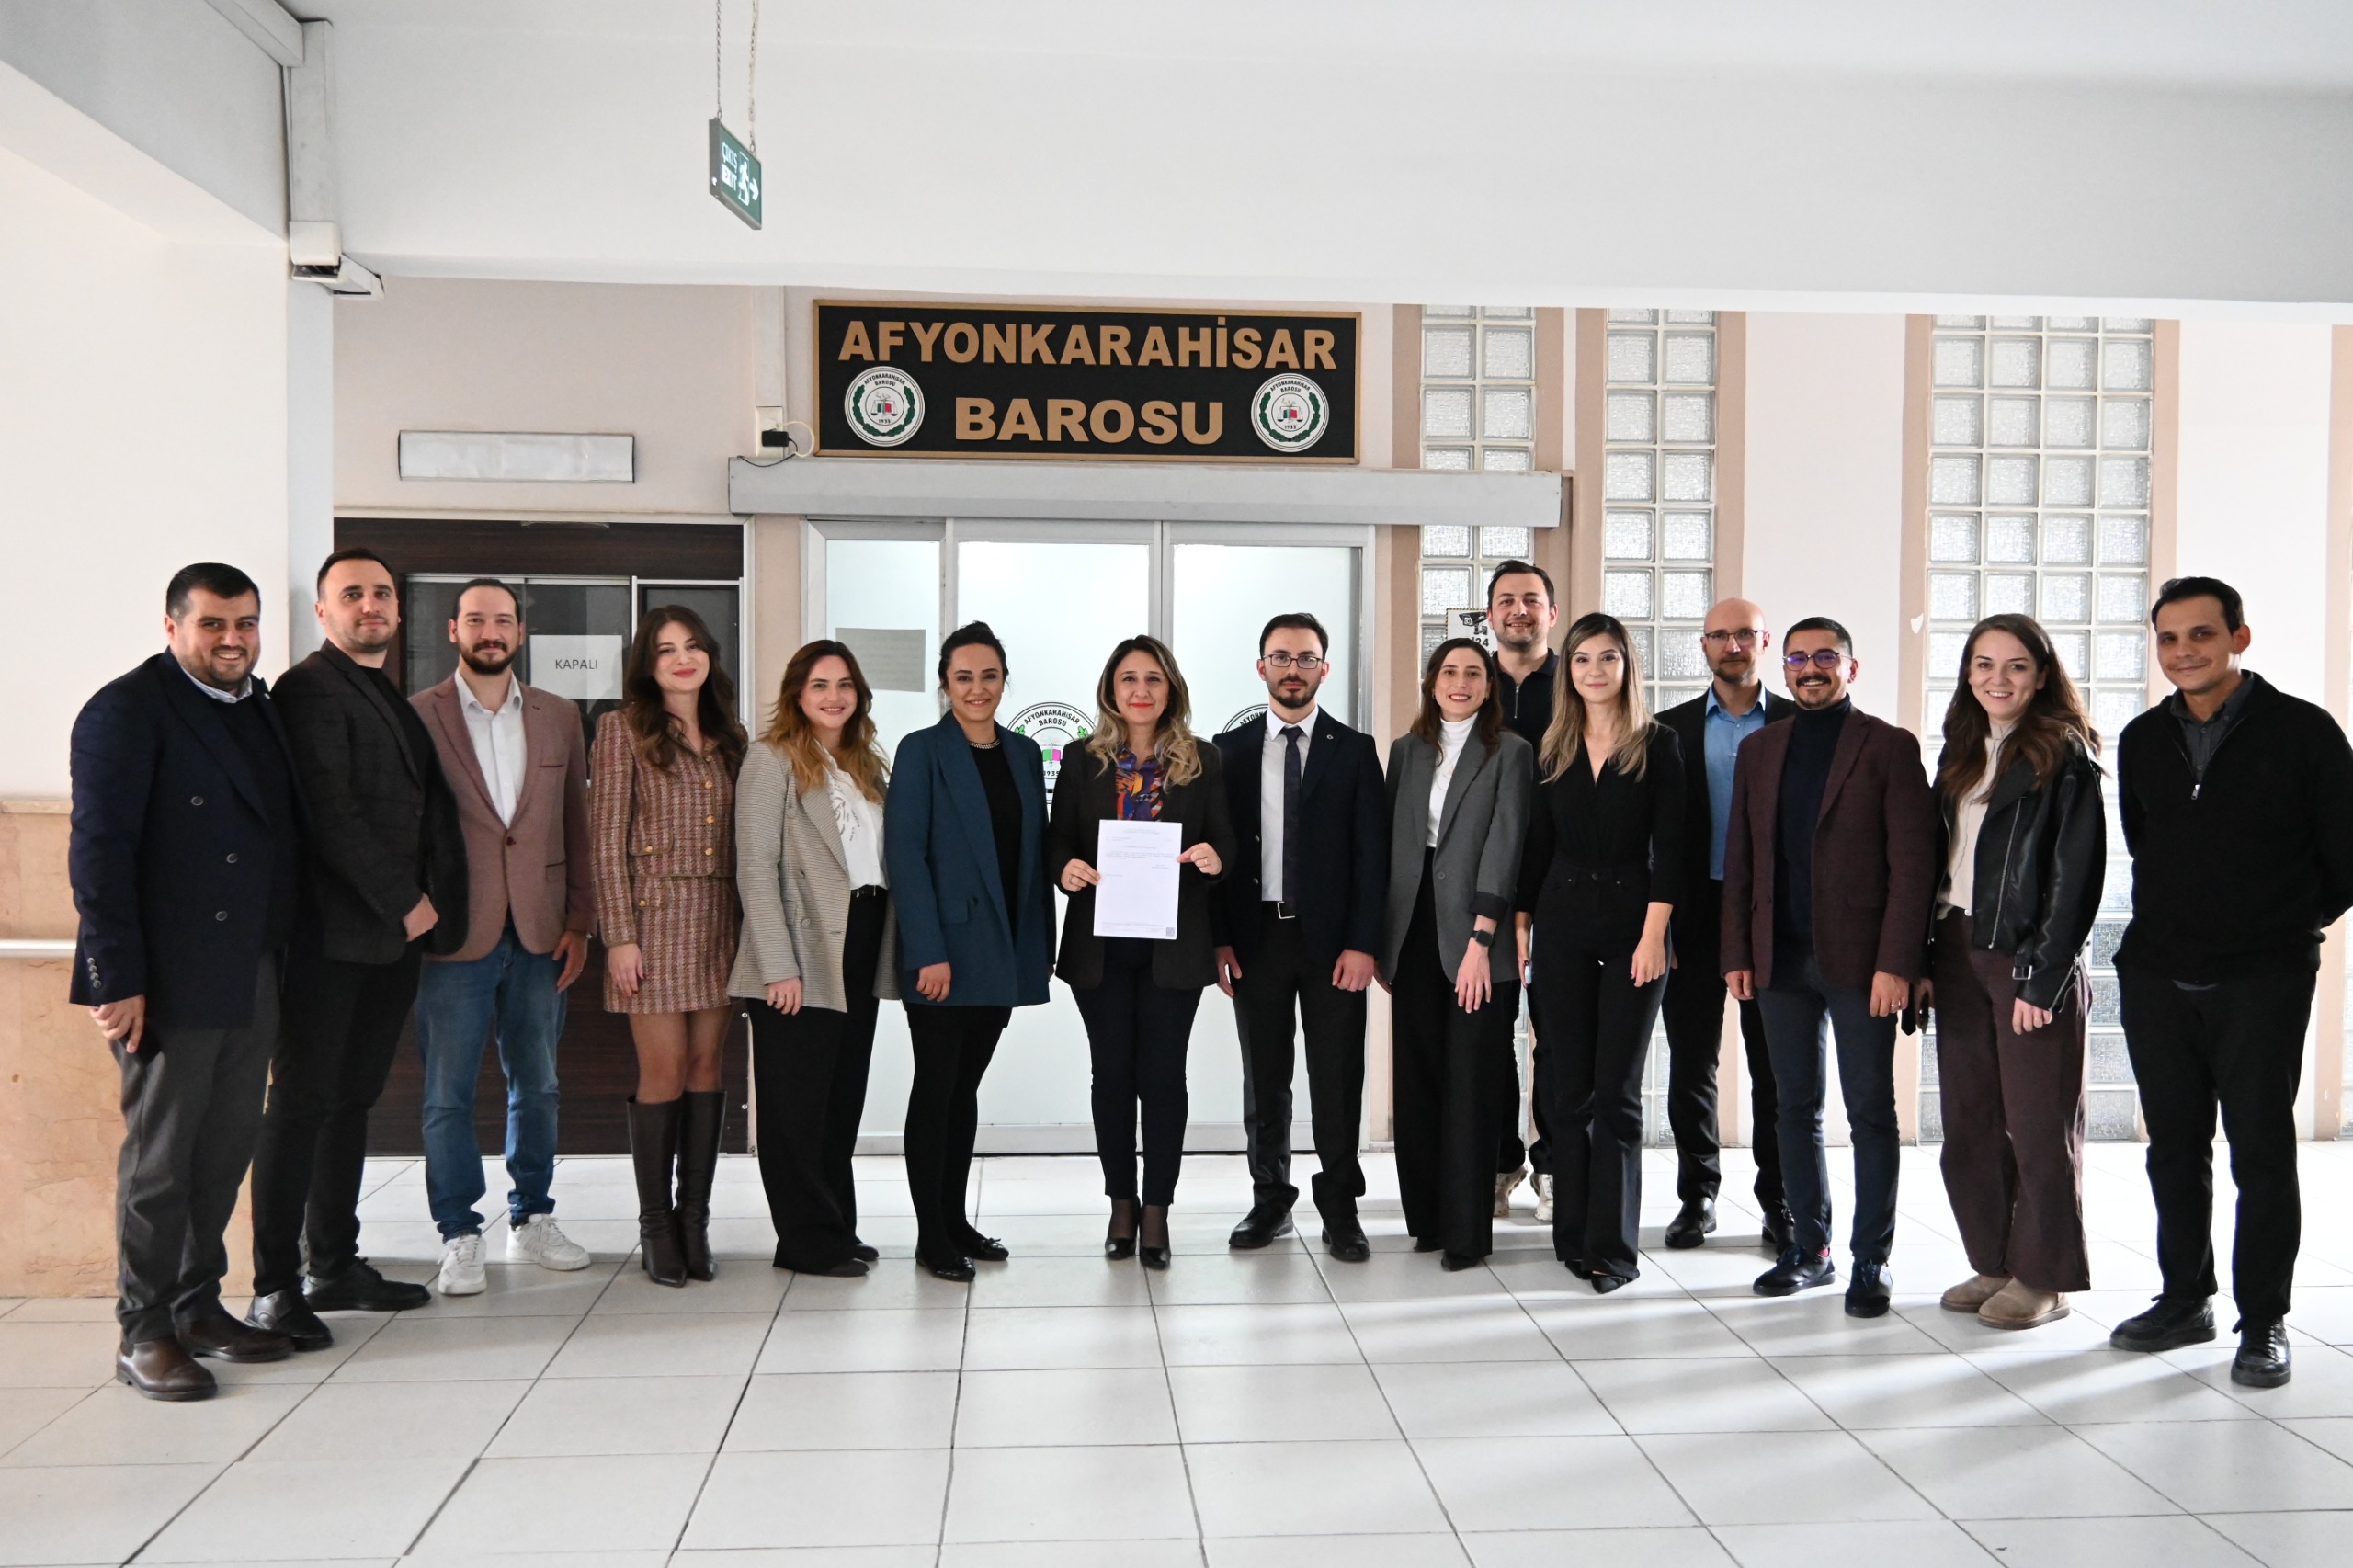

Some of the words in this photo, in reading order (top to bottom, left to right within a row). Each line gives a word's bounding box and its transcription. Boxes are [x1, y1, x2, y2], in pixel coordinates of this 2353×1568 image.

[838, 317, 1337, 370] AFYONKARAHİSAR
[955, 397, 1223, 446] BAROSU
[555, 659, 598, 670] KAPALI
[1039, 718, 1067, 727] BAROSU
